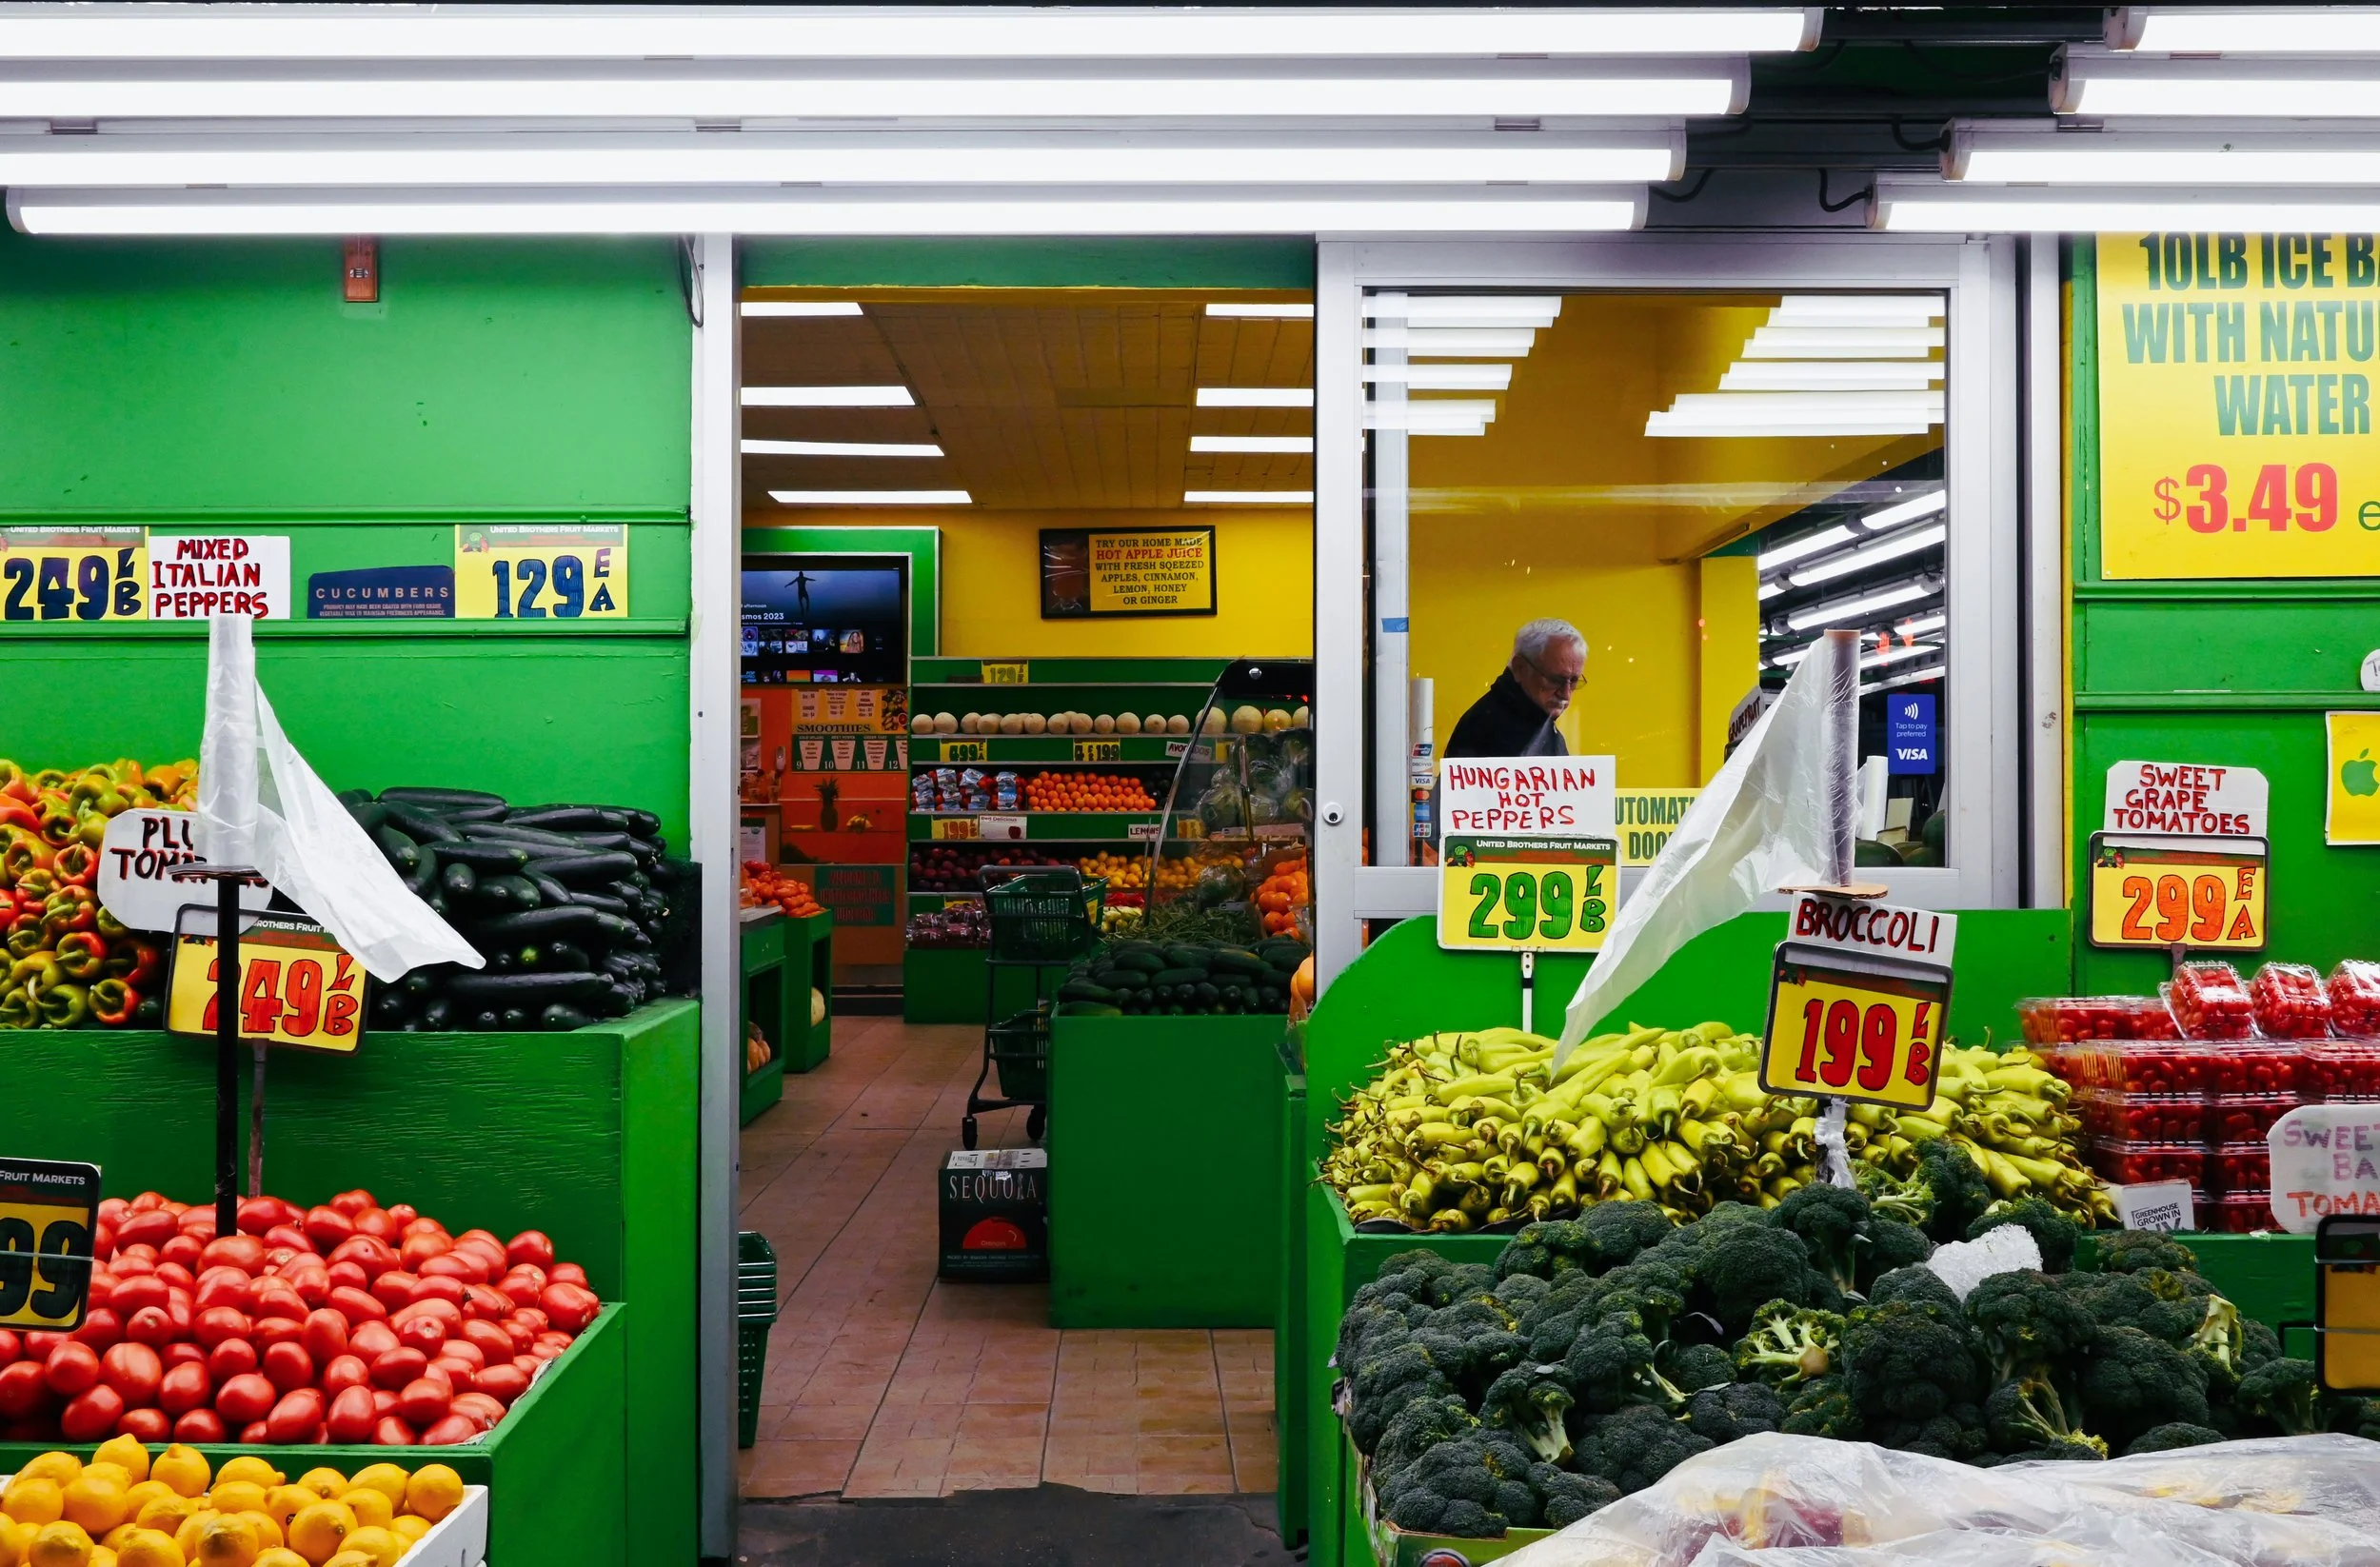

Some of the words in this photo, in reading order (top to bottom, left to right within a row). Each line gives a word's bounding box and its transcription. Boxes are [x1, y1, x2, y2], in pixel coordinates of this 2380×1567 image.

[2139, 231, 2249, 291] 10LB
[2261, 231, 2333, 289] ICE
[2344, 231, 2380, 288] B
[2122, 302, 2246, 364] WITH
[2259, 301, 2380, 363] NATU
[2213, 374, 2370, 436] WATER
[2153, 463, 2338, 534] $3.49
[176, 538, 249, 561] MIXED
[1096, 539, 1115, 548] TRY
[1119, 539, 1140, 547] OUR
[1142, 538, 1172, 547] HOME
[1175, 538, 1203, 546] MADE
[1096, 549, 1122, 560] HOT
[1126, 548, 1163, 560] APPLE
[1167, 547, 1203, 559] JUICE
[151, 560, 261, 588] ITALIAN
[1096, 562, 1121, 571] WITH
[1123, 561, 1157, 570] FRESH
[1159, 560, 1204, 570] SQEEZED
[1101, 573, 1140, 584] APPLES,
[1143, 571, 1200, 582] CINNAMON,
[3, 555, 109, 620] 249
[316, 587, 449, 599] CUCUMBERS
[492, 555, 585, 618] 129
[588, 547, 616, 612] EA
[1113, 585, 1151, 594] LEMON,
[1154, 584, 1187, 593] HONEY
[155, 591, 268, 619] PEPPERS
[1123, 596, 1137, 605] OR
[1140, 595, 1179, 605] GINGER
[797, 724, 871, 733] SMOOTHIES
[824, 761, 834, 769] 10
[888, 761, 899, 769] 12
[1895, 748, 1928, 760] VISA
[1449, 764, 1596, 791] HUNGARIAN
[2139, 764, 2226, 791] SWEET
[1498, 791, 1545, 808] HOT
[1615, 796, 1695, 824] UTOMAT
[2125, 787, 2208, 813] GRAPE
[942, 821, 969, 840] 199
[1451, 805, 1575, 831] PEPPERS
[2113, 808, 2250, 834] TOMATOES
[1477, 840, 1505, 848] UNITED
[1507, 841, 1548, 849] BROTHERS
[1550, 841, 1572, 850] FRUIT
[1574, 842, 1611, 850] MARKETS
[1629, 831, 1674, 860] DOO
[1468, 871, 1574, 940] 299
[1579, 865, 1606, 933] LB
[2122, 874, 2226, 942] 299
[2226, 865, 2256, 941] EA
[296, 922, 322, 932] FRUIT
[1795, 898, 1939, 953] BROCCOLI
[323, 953, 358, 1036] LB
[1795, 998, 1897, 1091] 199
[1904, 1001, 1931, 1086] LB
[32, 1172, 86, 1185] MARKETS
[2134, 1202, 2178, 1219] GREENHOUSE
[2137, 1212, 2171, 1226] GROWN
[2172, 1209, 2181, 1218] IN
